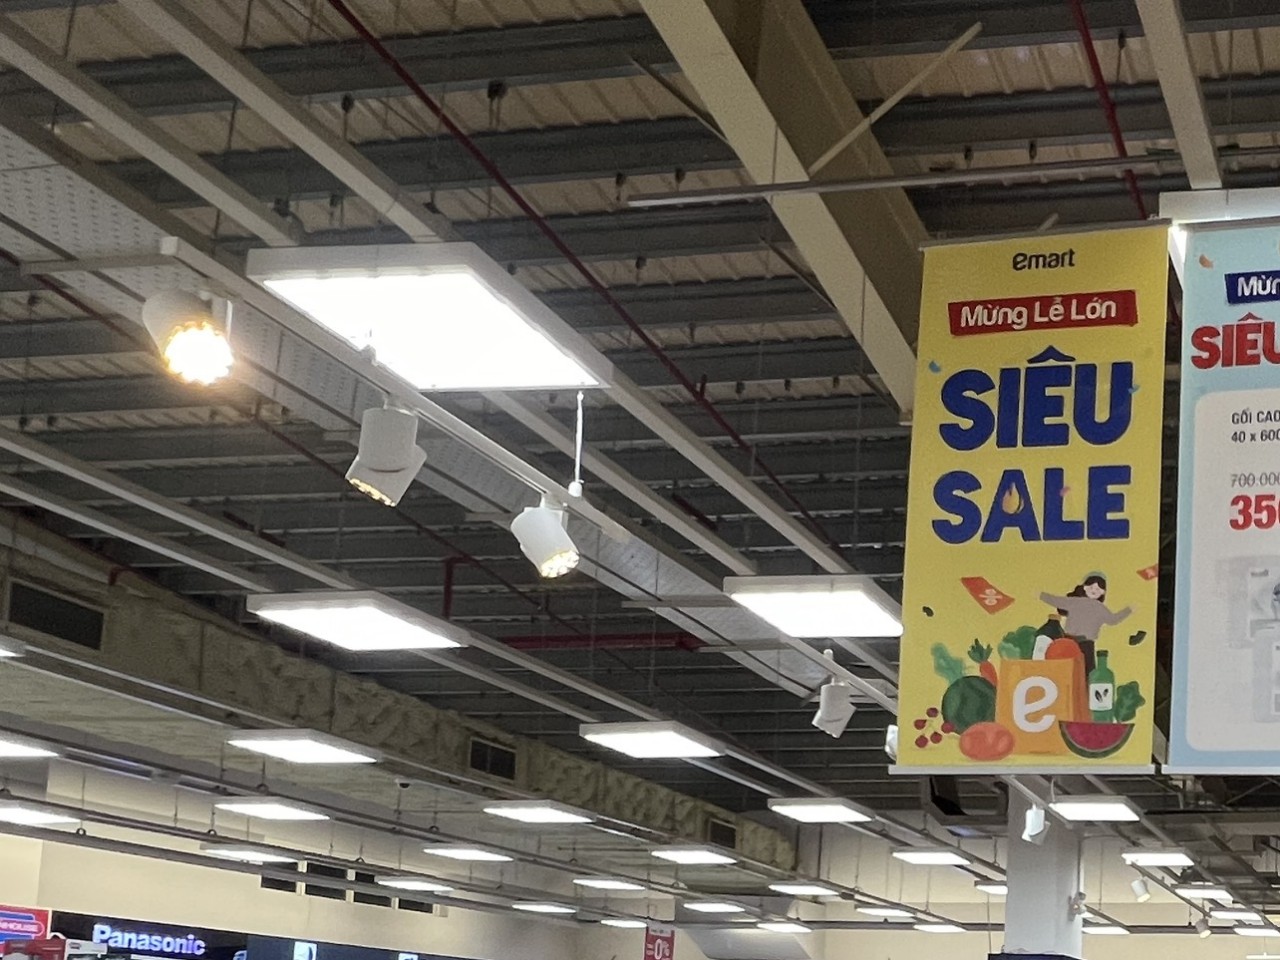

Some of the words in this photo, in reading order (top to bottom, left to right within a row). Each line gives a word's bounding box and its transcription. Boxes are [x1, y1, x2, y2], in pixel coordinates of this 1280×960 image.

[1012, 249, 1076, 271] emart
[961, 303, 1028, 330] Mừng
[1034, 297, 1064, 322] Lễ
[1071, 297, 1117, 320] Lớn
[938, 345, 1132, 451] SIÊU
[1231, 407, 1252, 425] GỐI
[1231, 430, 1246, 443] 40
[1250, 433, 1256, 442] x
[931, 465, 1132, 545] SALE
[1012, 676, 1059, 734] e
[92, 924, 206, 956] Panasonic
